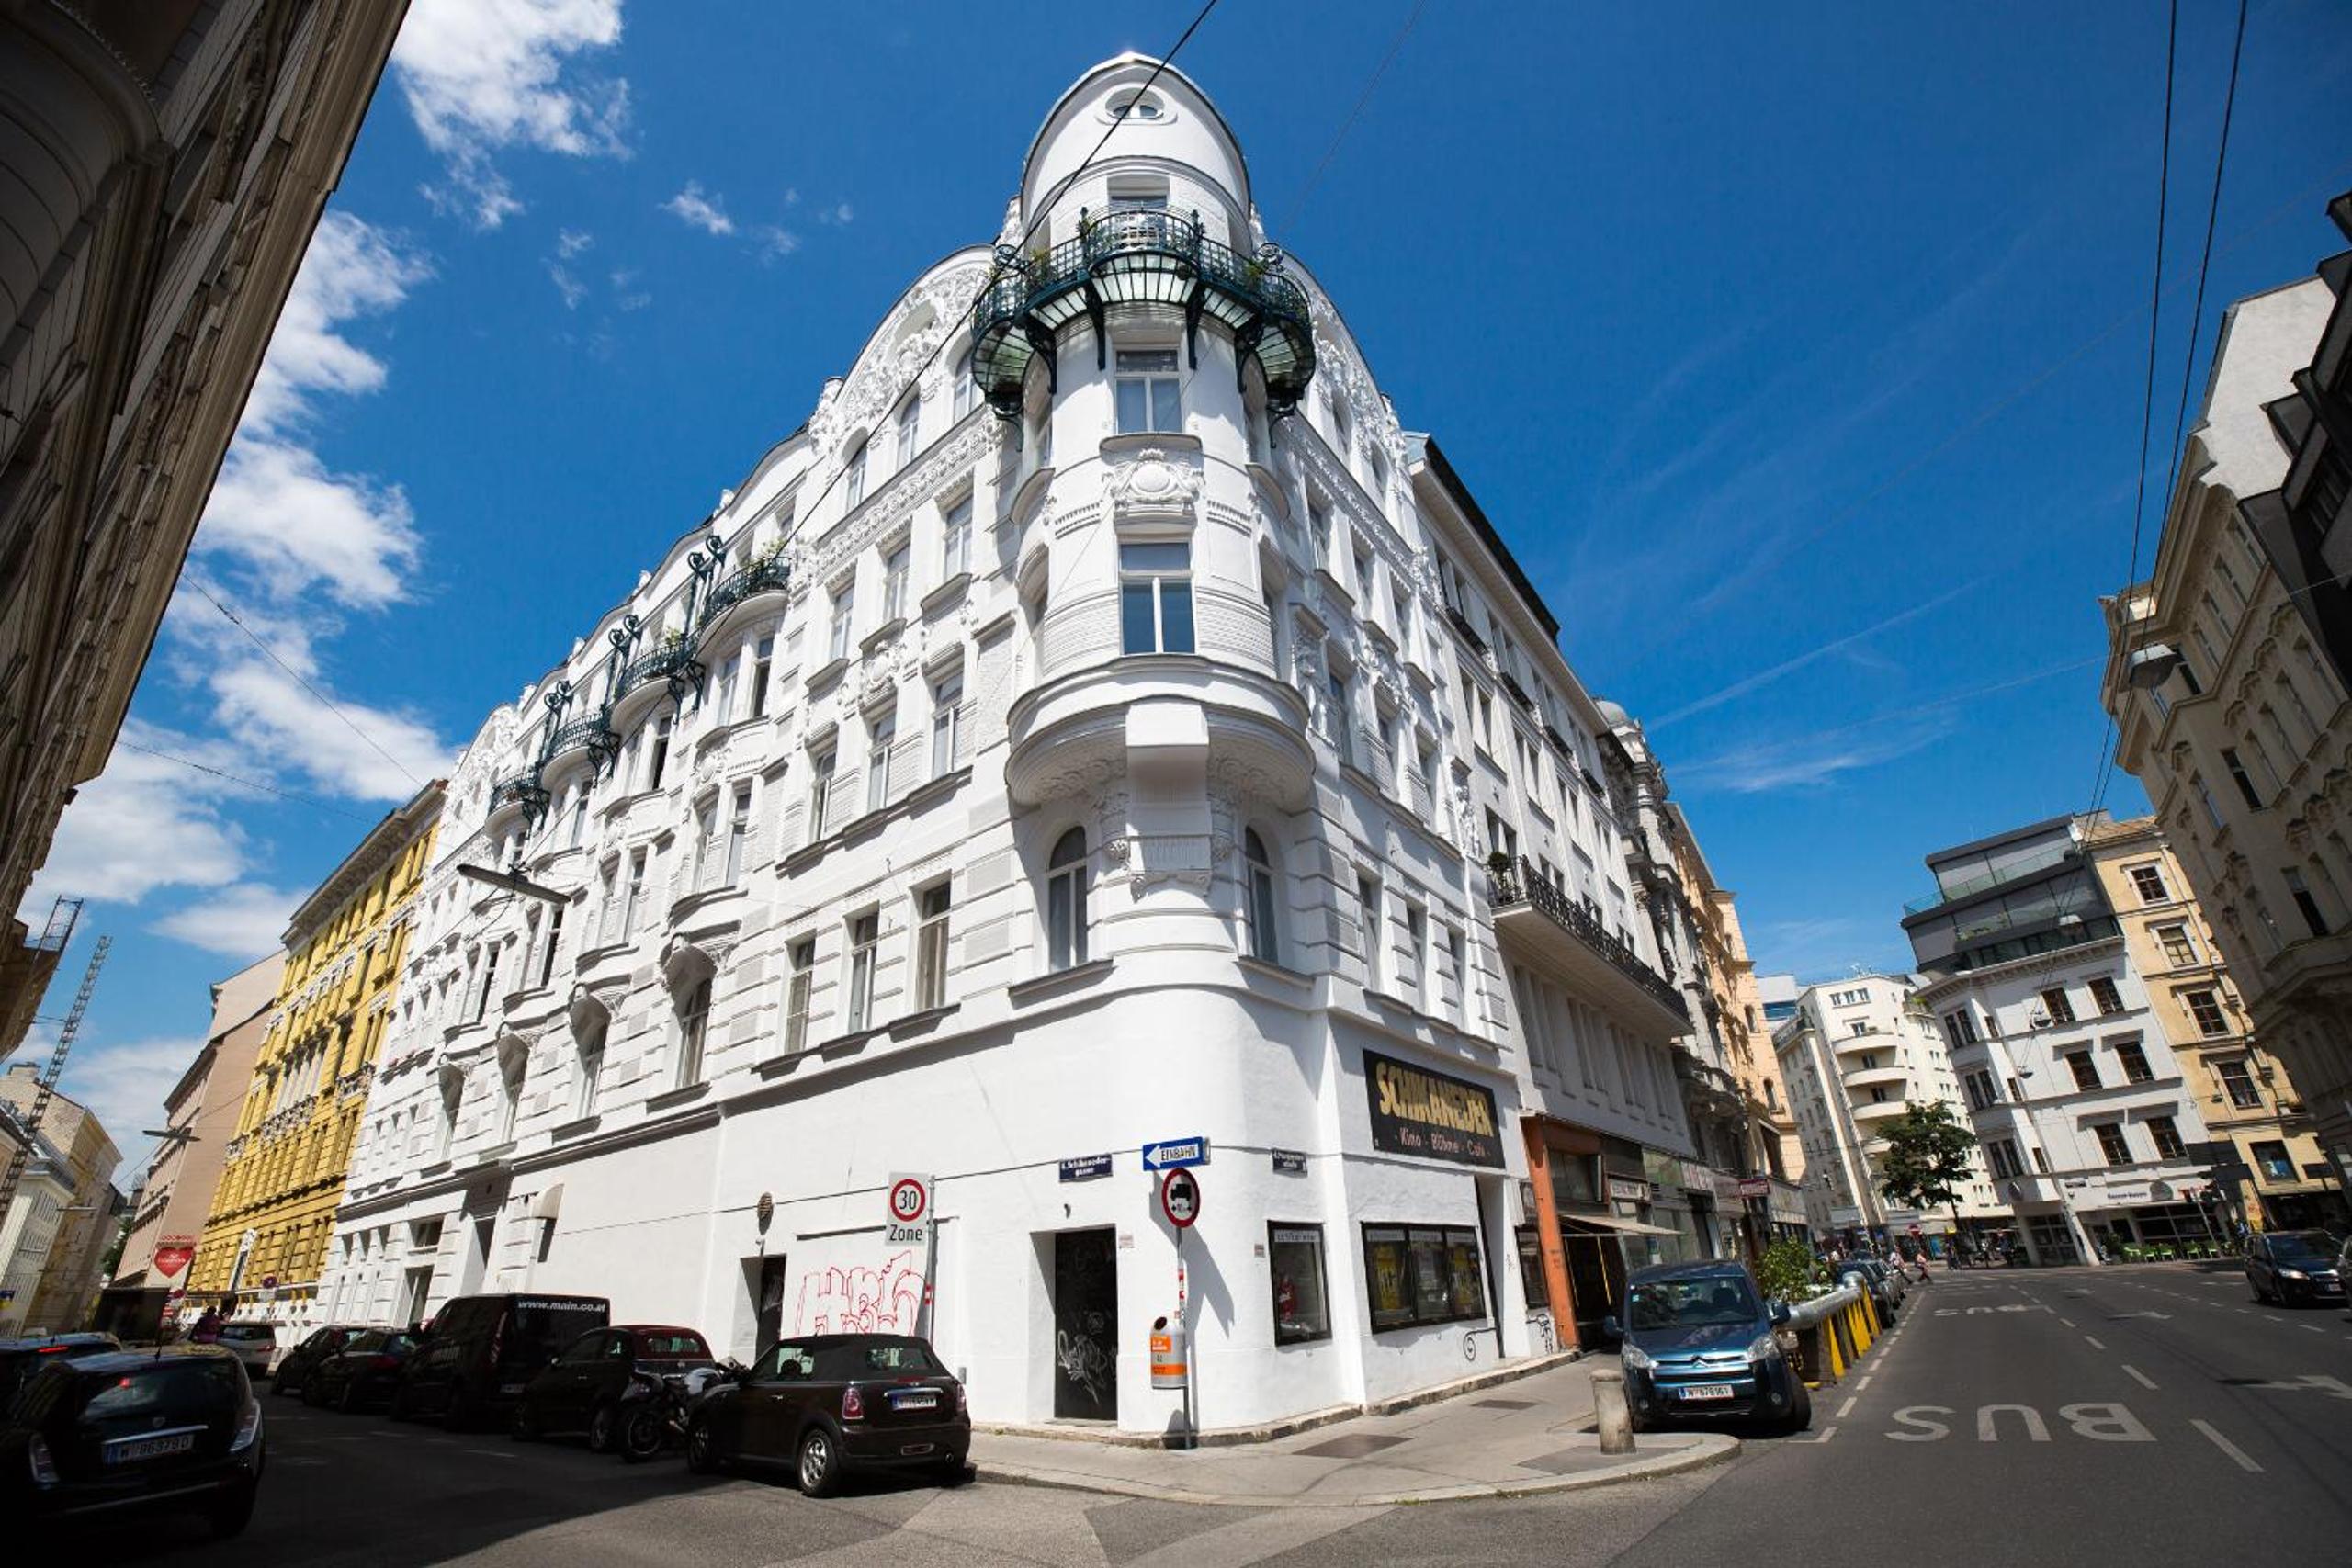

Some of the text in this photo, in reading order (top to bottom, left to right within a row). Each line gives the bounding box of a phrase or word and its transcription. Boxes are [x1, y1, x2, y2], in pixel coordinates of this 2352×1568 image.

[1400, 1127, 1421, 1147] Kino
[1160, 1146, 1195, 1161] EINBAHN
[899, 1190, 917, 1210] 30
[889, 1224, 922, 1241] Zone
[1885, 1403, 2157, 1442] BUS
